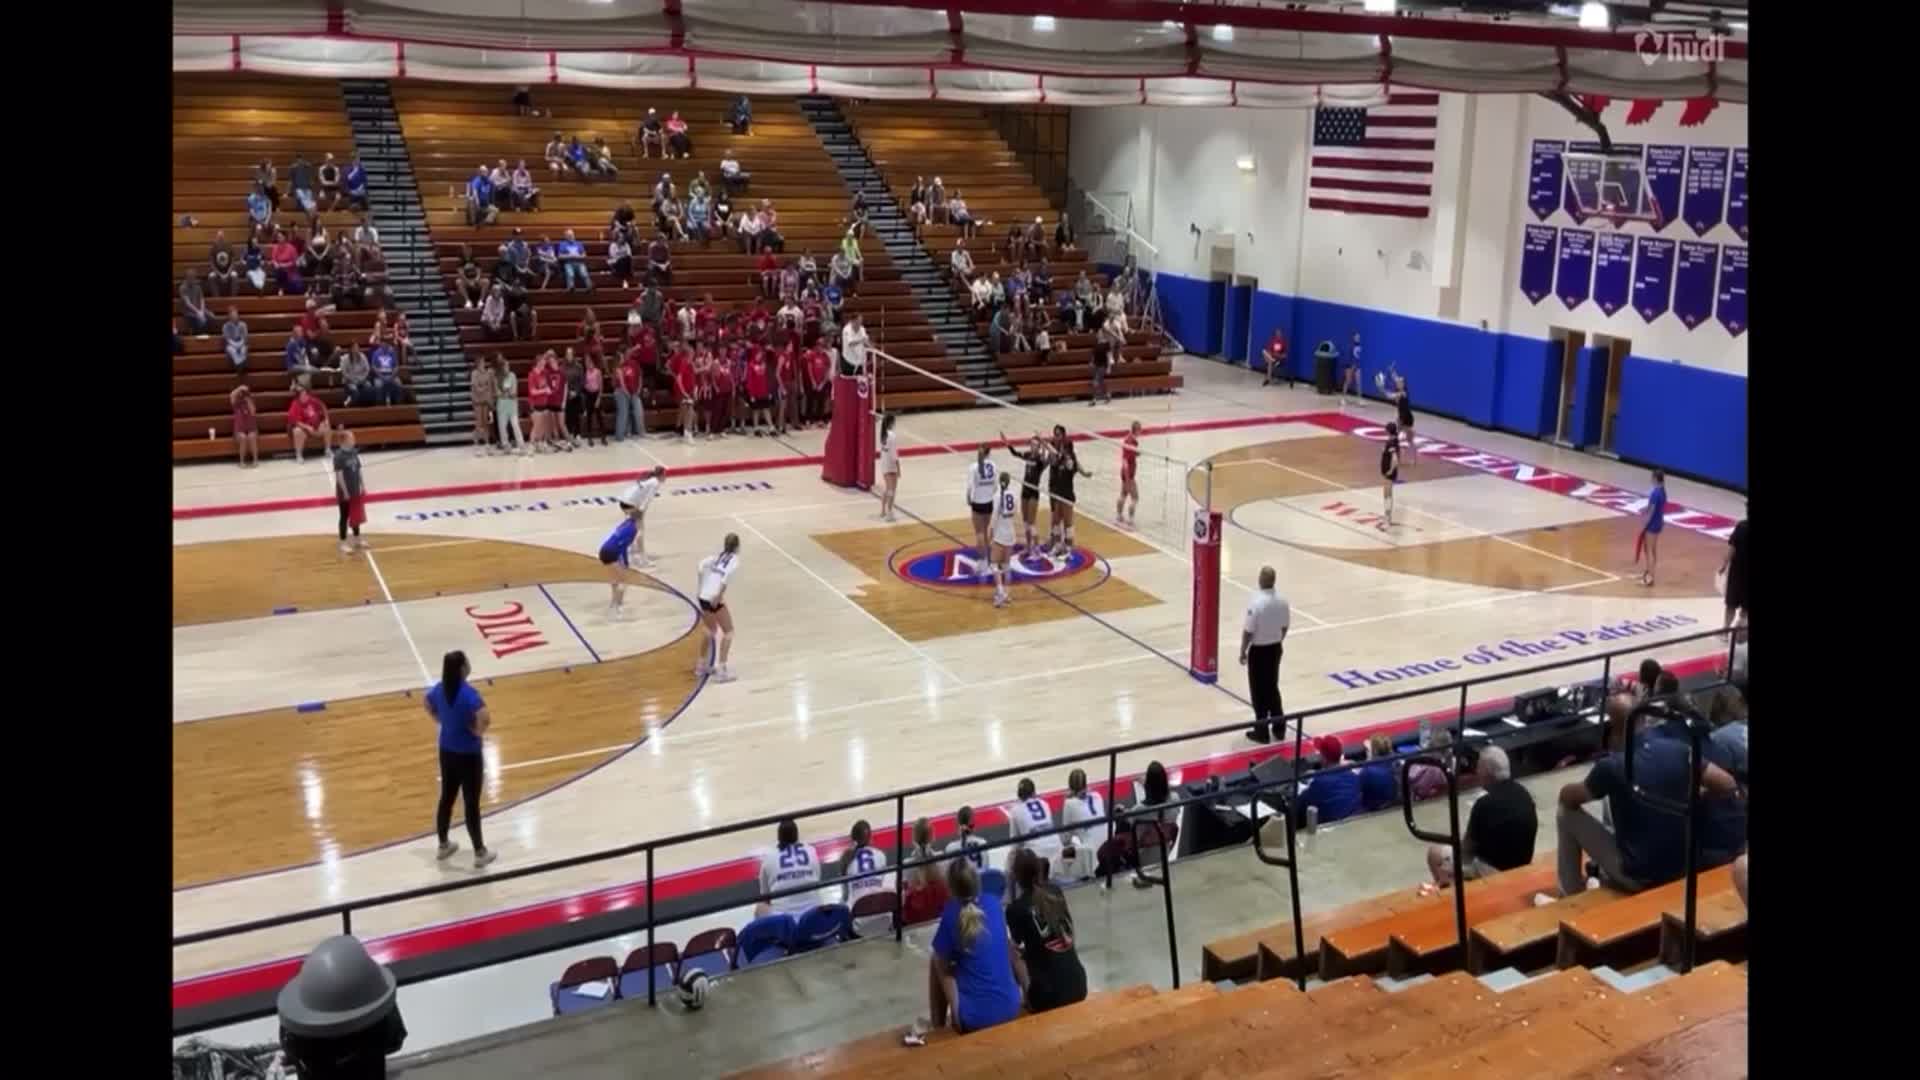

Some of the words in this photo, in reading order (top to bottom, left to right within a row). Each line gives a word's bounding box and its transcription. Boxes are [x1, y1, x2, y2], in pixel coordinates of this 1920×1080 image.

[464, 601, 550, 659] WIC
[1329, 657, 1462, 690] Home
[1463, 645, 1502, 666] of
[1498, 639, 1560, 661] the
[1556, 612, 1699, 650] Patriots
[1026, 799, 1046, 820] 9
[779, 842, 810, 869] 25
[856, 846, 876, 873] 6
